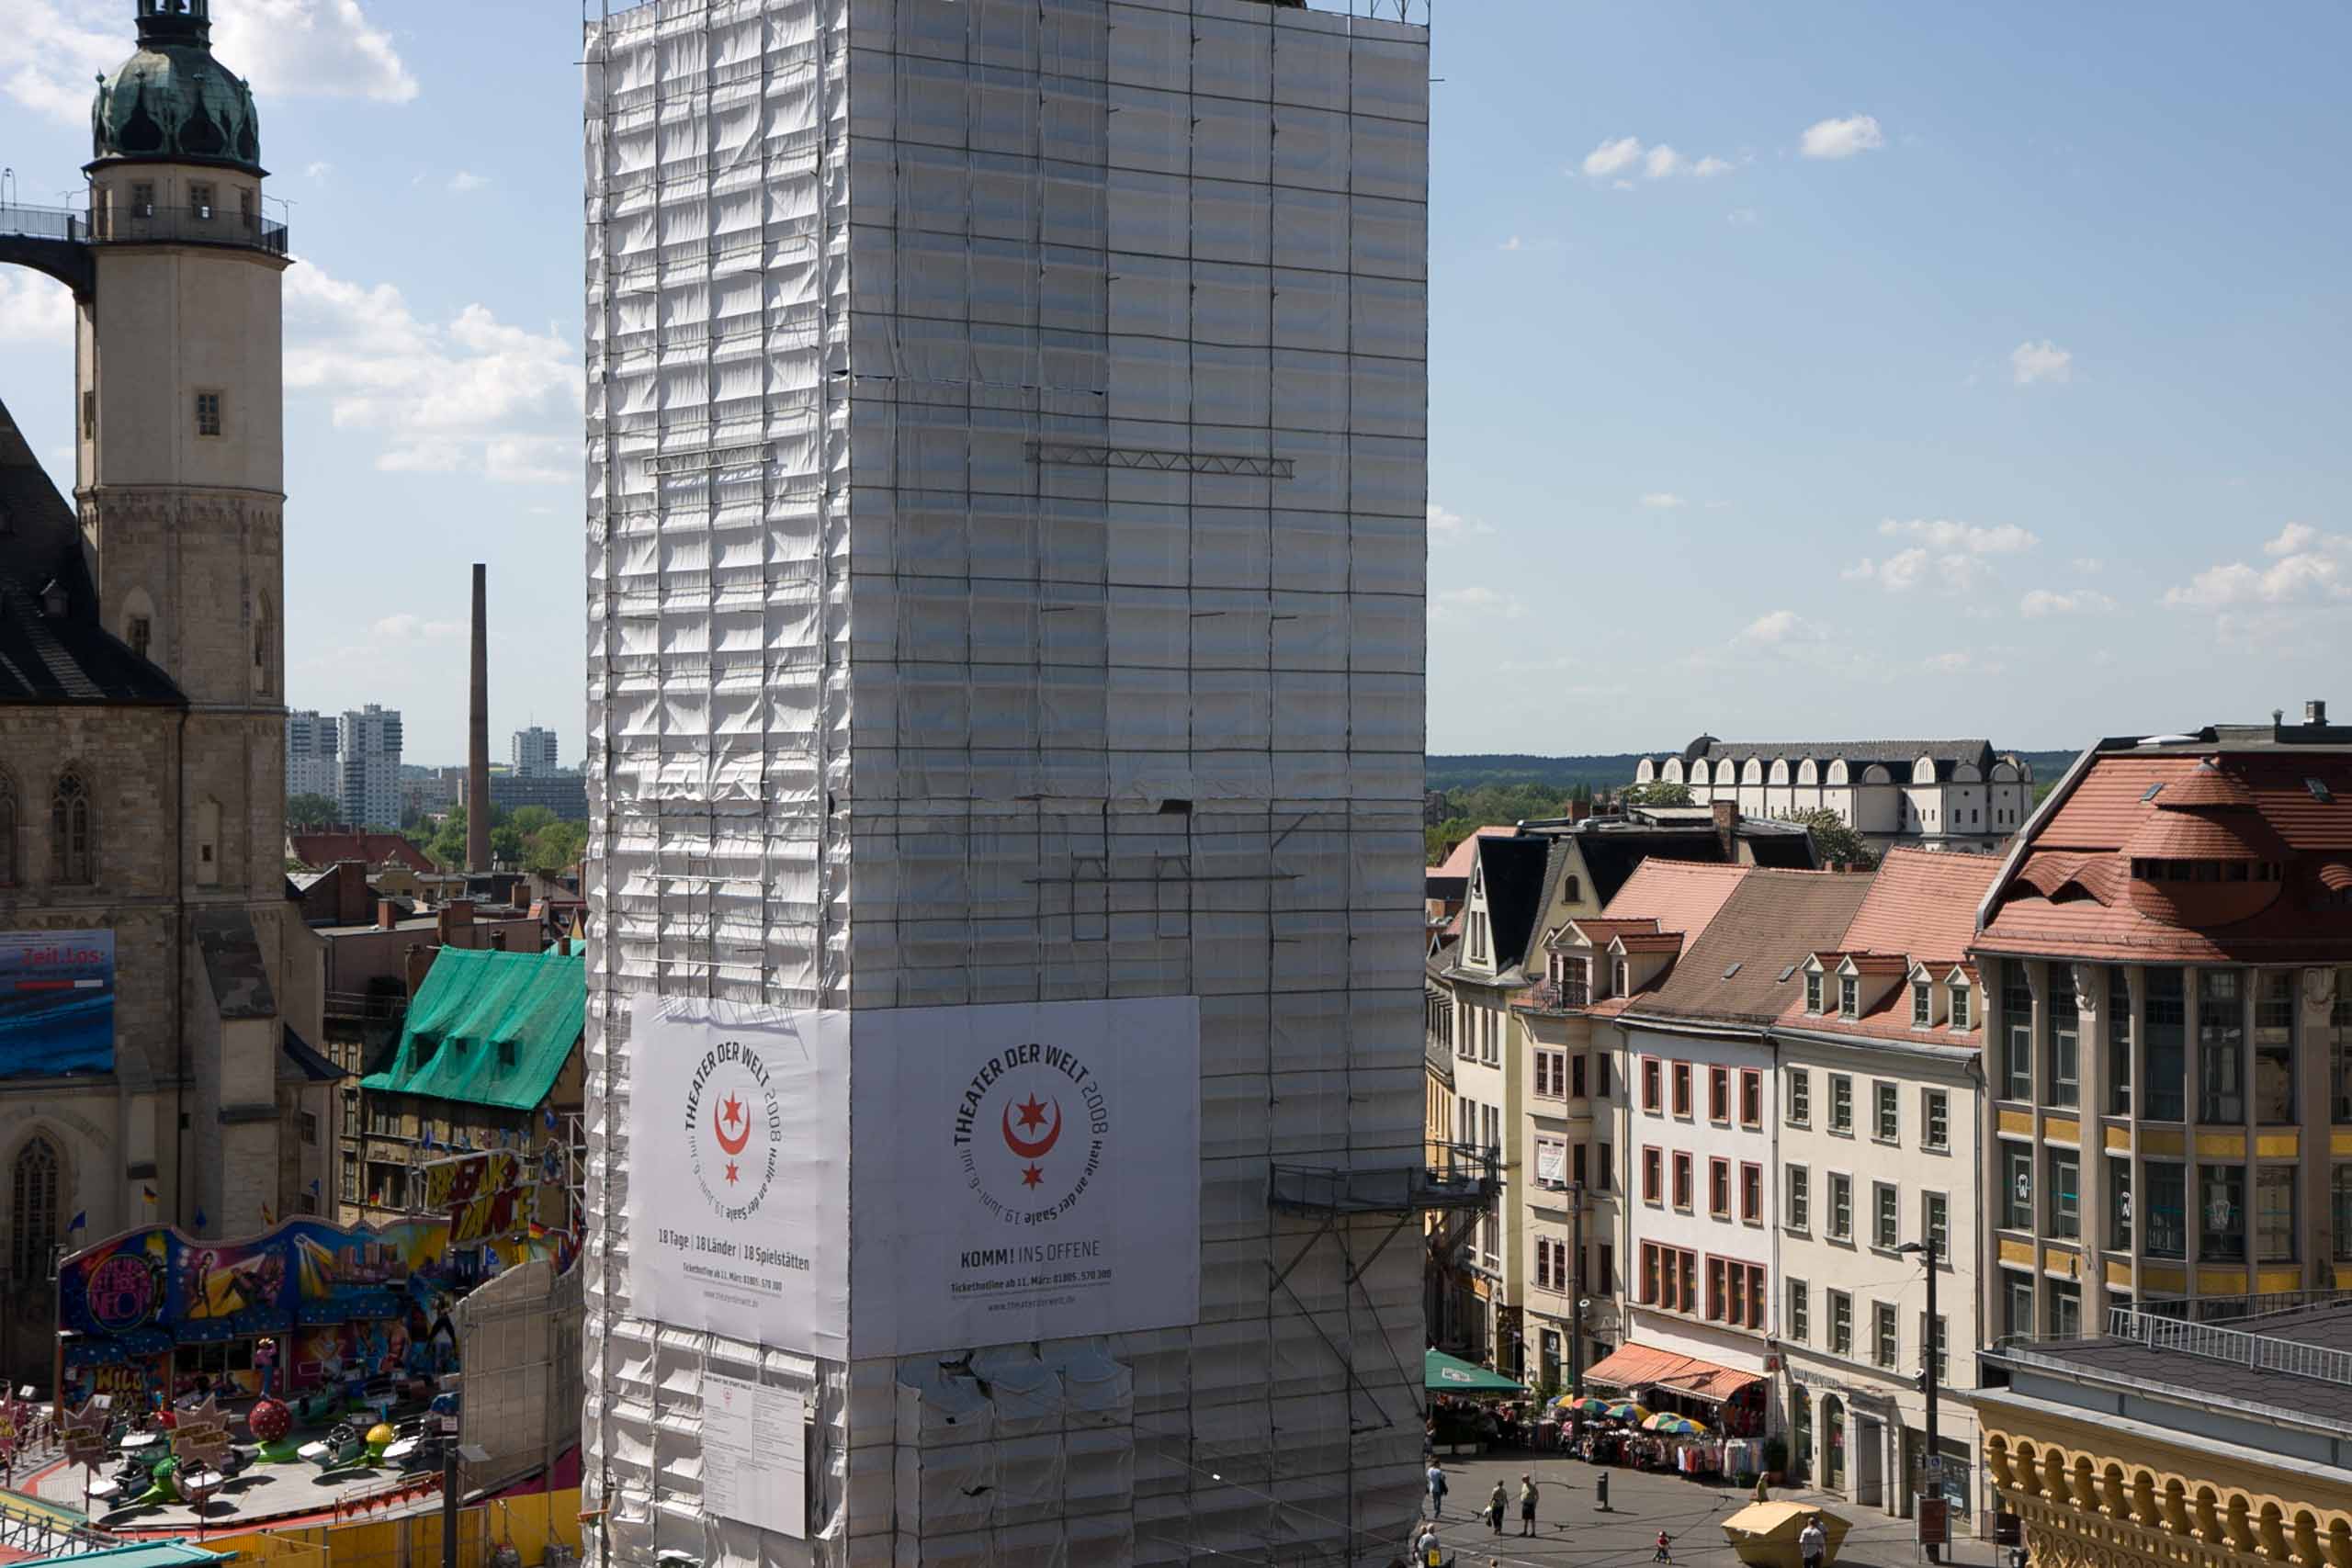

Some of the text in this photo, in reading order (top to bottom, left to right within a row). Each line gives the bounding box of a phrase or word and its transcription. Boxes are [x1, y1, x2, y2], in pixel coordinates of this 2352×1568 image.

[685, 1042, 782, 1142] THEATER DER WELT 2008
[954, 1043, 1108, 1146] THEATER DER WELT 2008
[765, 1147, 777, 1182] Halle
[960, 1149, 977, 1173] Juli
[1023, 1140, 1102, 1225] Halle an der Saale
[726, 1206, 748, 1222] Saale
[978, 1191, 1002, 1219] Juni
[659, 1228, 809, 1271] 18 Tage 18 Länder 18 Spielstätten
[961, 1240, 1101, 1269] KOMM! INS OFFENE
[1005, 1278, 1015, 1288] ab
